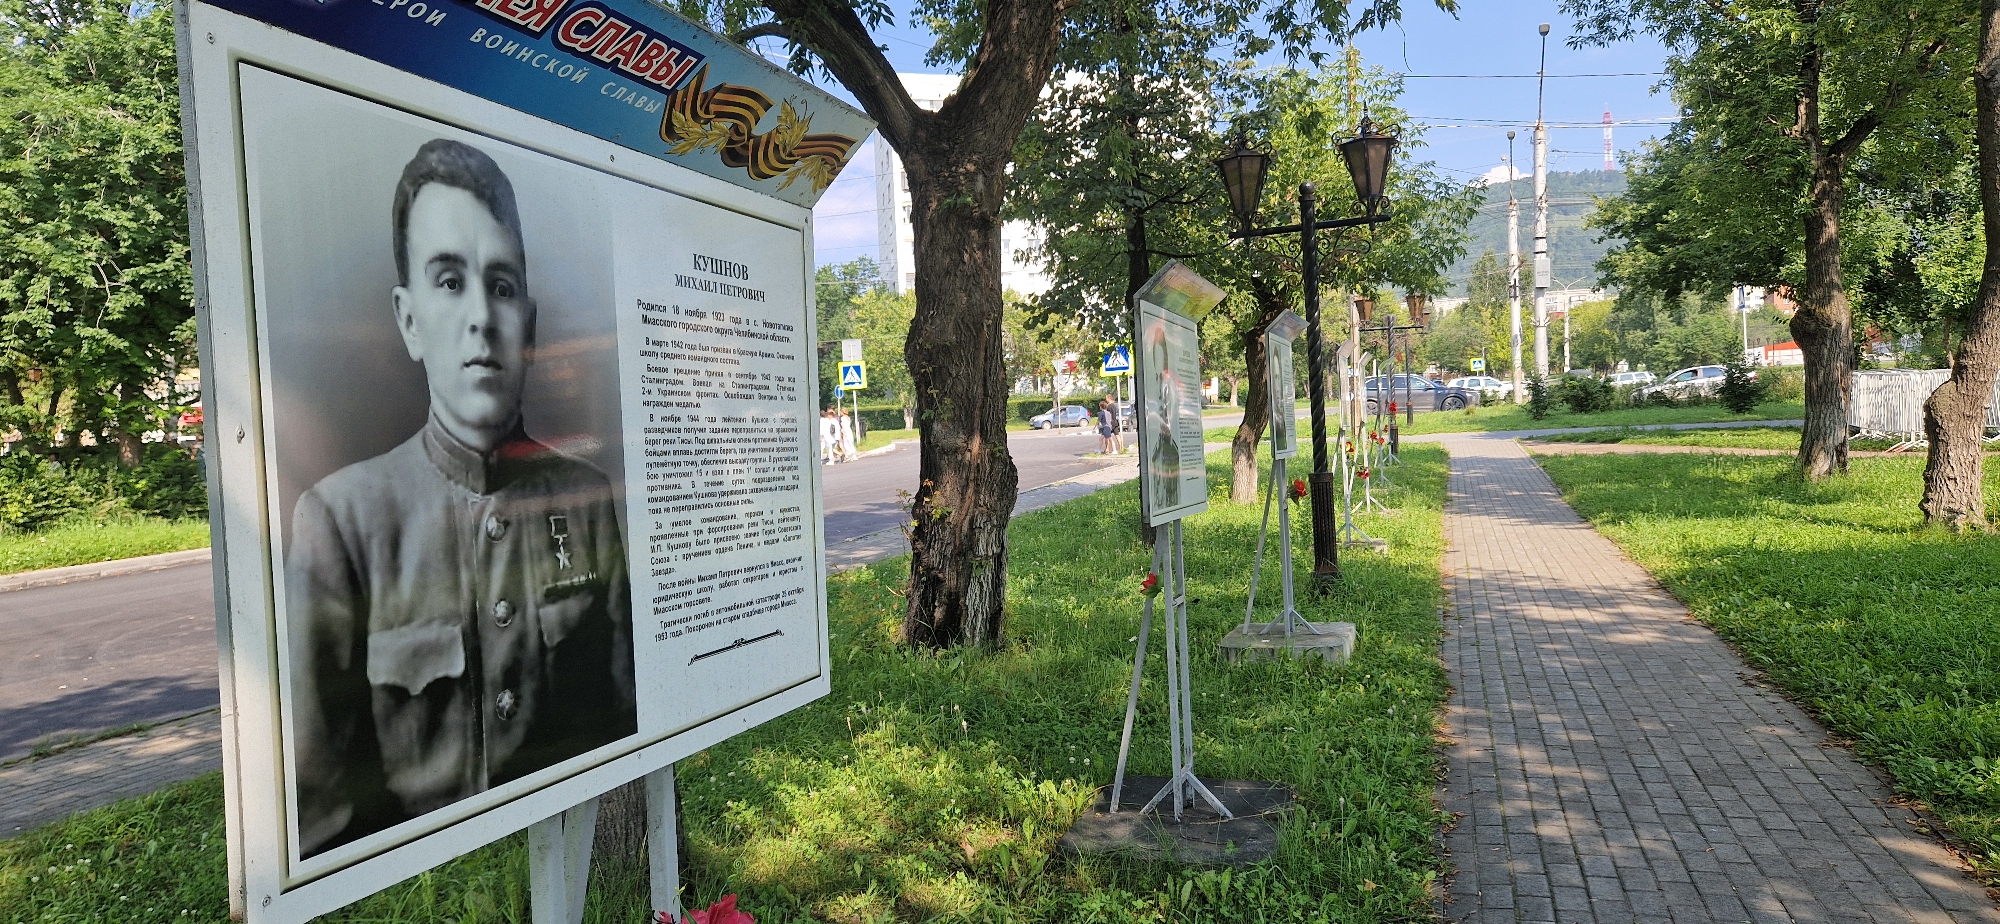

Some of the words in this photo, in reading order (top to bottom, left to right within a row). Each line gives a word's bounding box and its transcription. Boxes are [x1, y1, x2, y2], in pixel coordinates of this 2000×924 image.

[557, 6, 698, 90] СЛАВЫ
[469, 27, 590, 84] ВОИНСКОЙ
[600, 81, 662, 114] СЛАВЫ
[692, 253, 749, 281] КУШНОВ
[674, 273, 718, 295] МИХАИЛ
[719, 283, 766, 303] ПЕТРОВИЧ
[637, 299, 667, 315] Родился
[672, 304, 680, 316] 18
[684, 306, 707, 322] ноября
[712, 311, 725, 322] 1923
[729, 316, 742, 326] года
